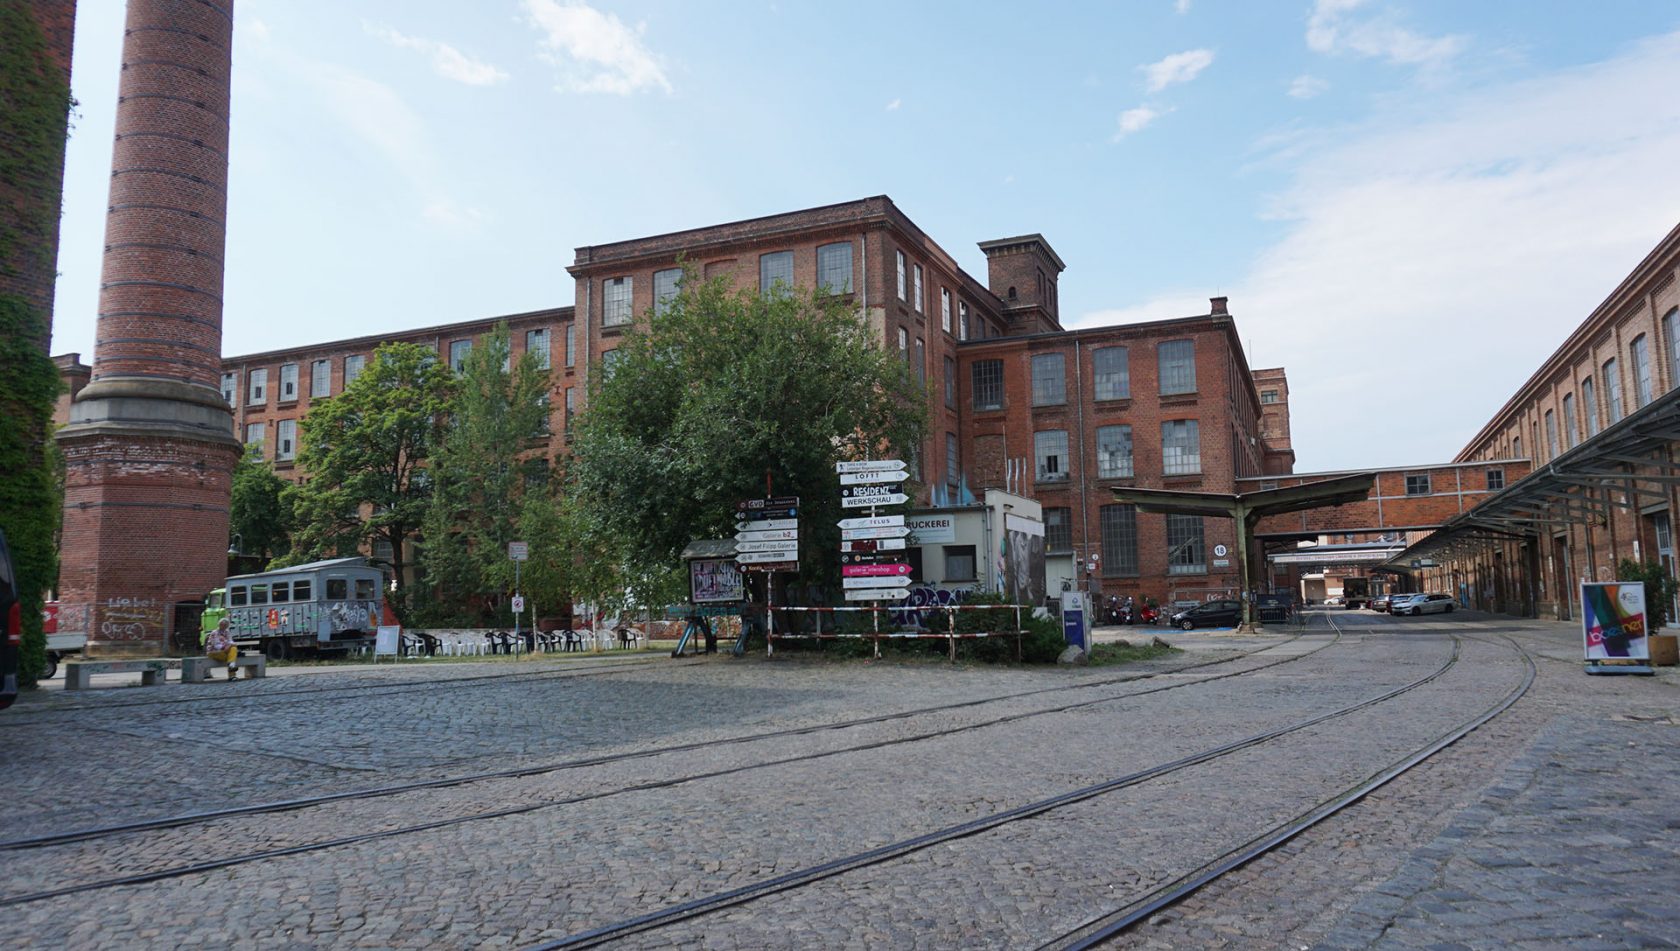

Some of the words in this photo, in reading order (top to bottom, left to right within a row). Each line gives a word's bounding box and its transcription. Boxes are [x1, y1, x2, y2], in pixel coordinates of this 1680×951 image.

[853, 485, 891, 497] RESIDENZ
[847, 497, 891, 506] WERKSCHAU
[904, 519, 950, 529] RUCKEREI
[1215, 546, 1225, 555] 18
